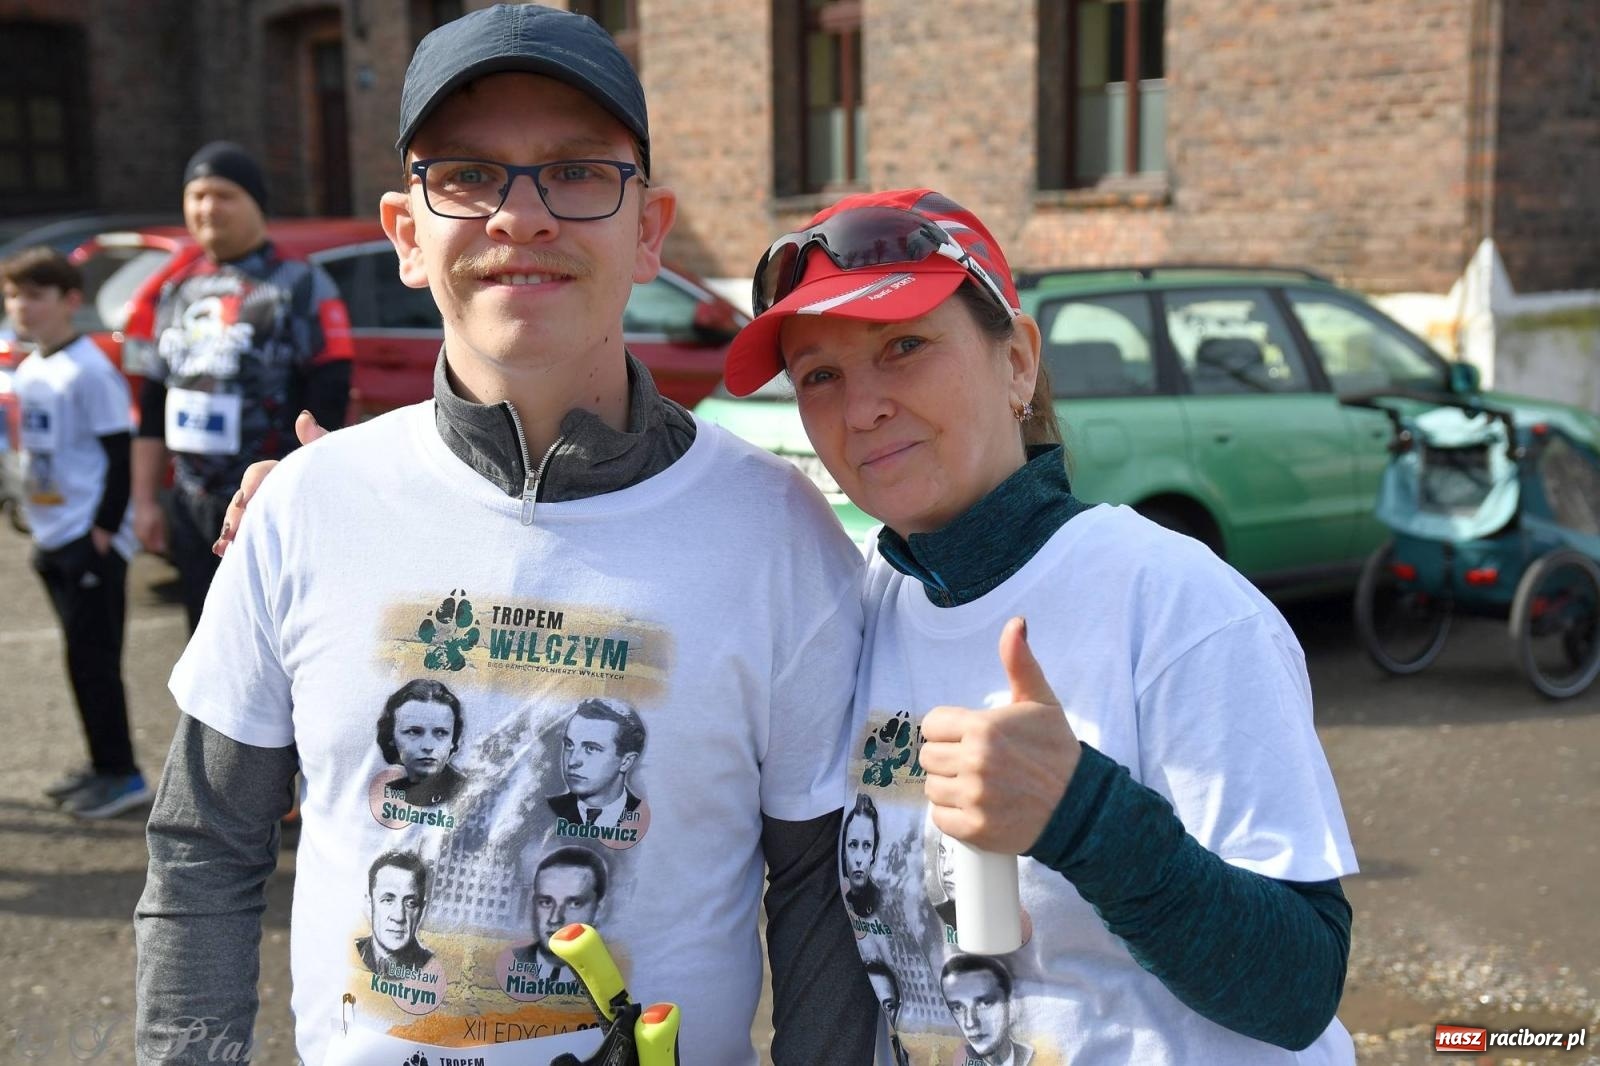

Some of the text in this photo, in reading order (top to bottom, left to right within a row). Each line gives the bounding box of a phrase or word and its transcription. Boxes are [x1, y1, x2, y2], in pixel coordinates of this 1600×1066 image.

[492, 605, 564, 630] TROPEM
[489, 628, 629, 671] WILCZYM
[383, 785, 406, 801] Ewa
[381, 801, 456, 829] Stolarska
[555, 816, 639, 842] Rodowicz
[508, 959, 543, 977] Jerzy
[371, 974, 437, 1006] Kontrym
[463, 1018, 487, 1041] XII
